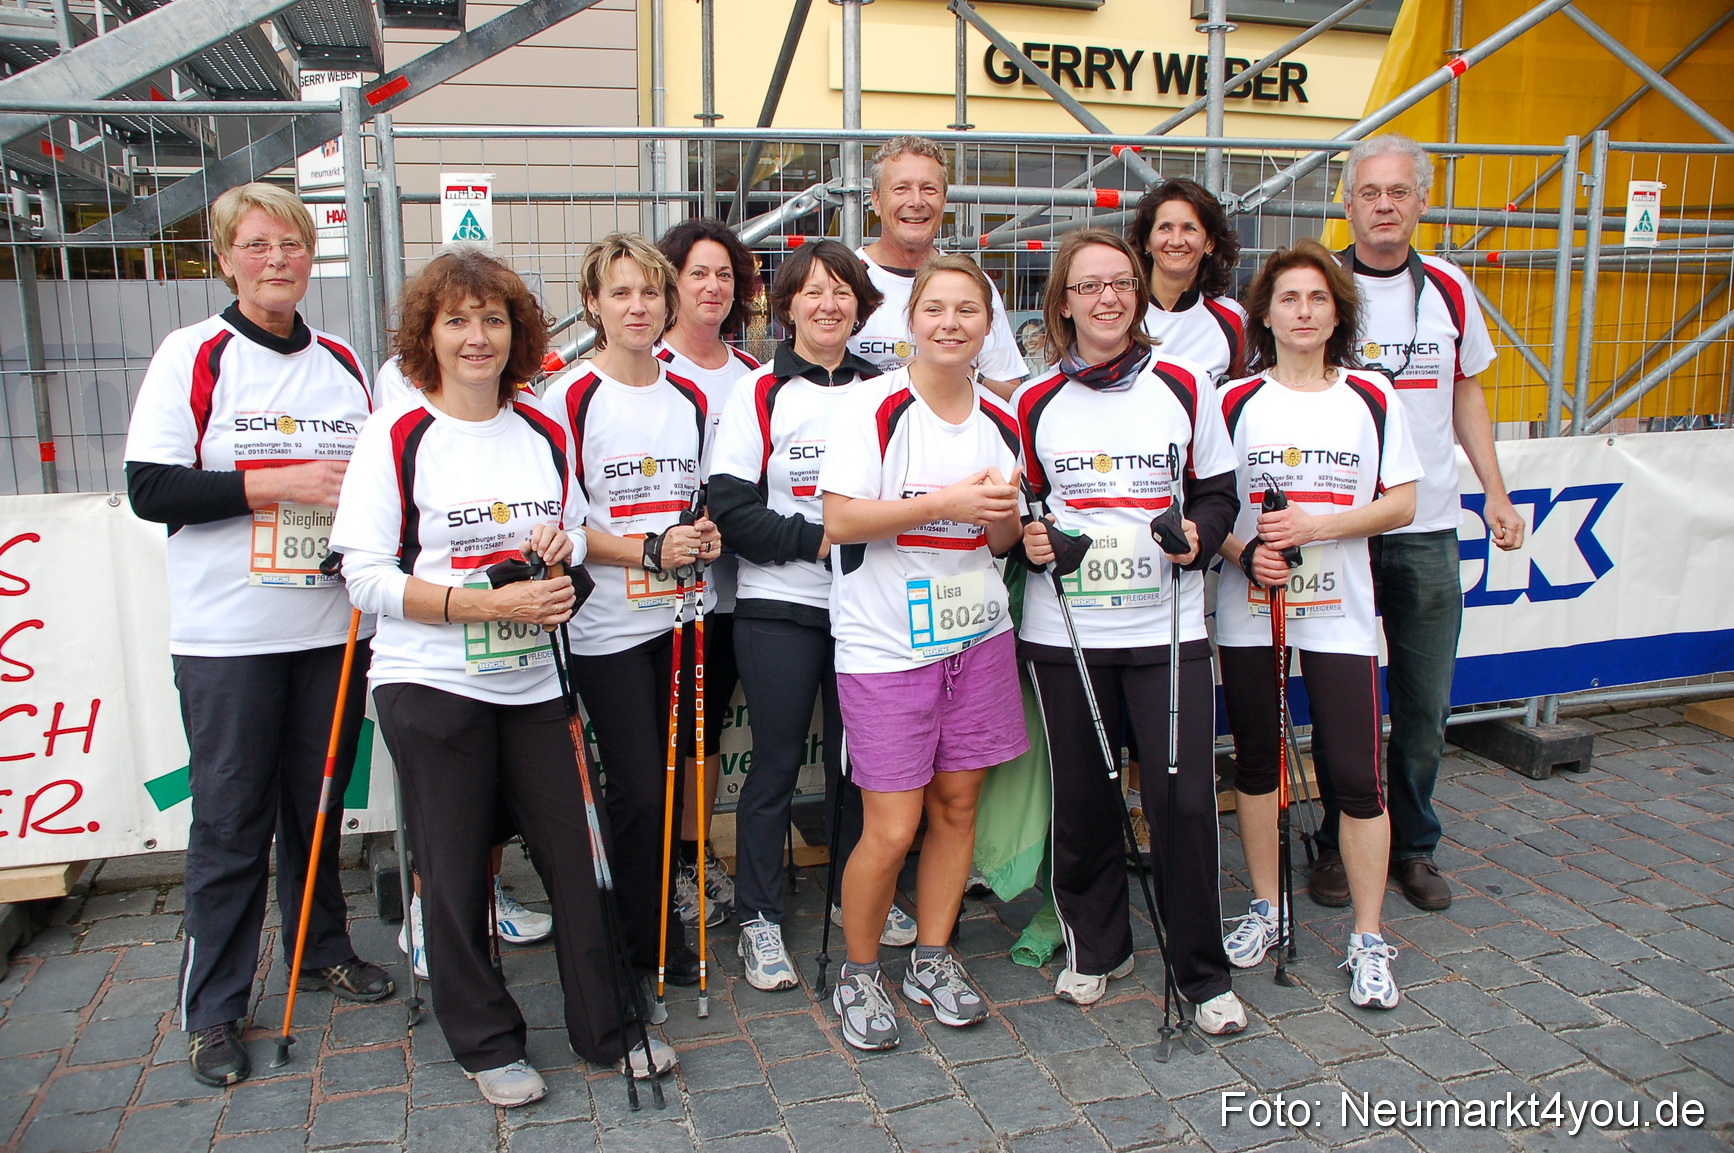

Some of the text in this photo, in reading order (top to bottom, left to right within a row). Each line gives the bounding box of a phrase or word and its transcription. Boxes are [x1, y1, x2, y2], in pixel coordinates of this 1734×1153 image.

[983, 41, 1145, 91] GERRY
[300, 71, 358, 87] GERRY WEBER
[310, 167, 340, 178] neumarkt
[235, 415, 358, 435] SCHOTTNER
[1247, 447, 1360, 468] SCHOTTNER
[283, 509, 336, 529] Sieglind
[450, 534, 496, 546] Regensburger
[1089, 535, 1117, 549] ucia
[1087, 557, 1152, 581] 8035
[936, 584, 962, 600] Lisa
[1285, 571, 1336, 594] 045
[939, 600, 1000, 630] 8029
